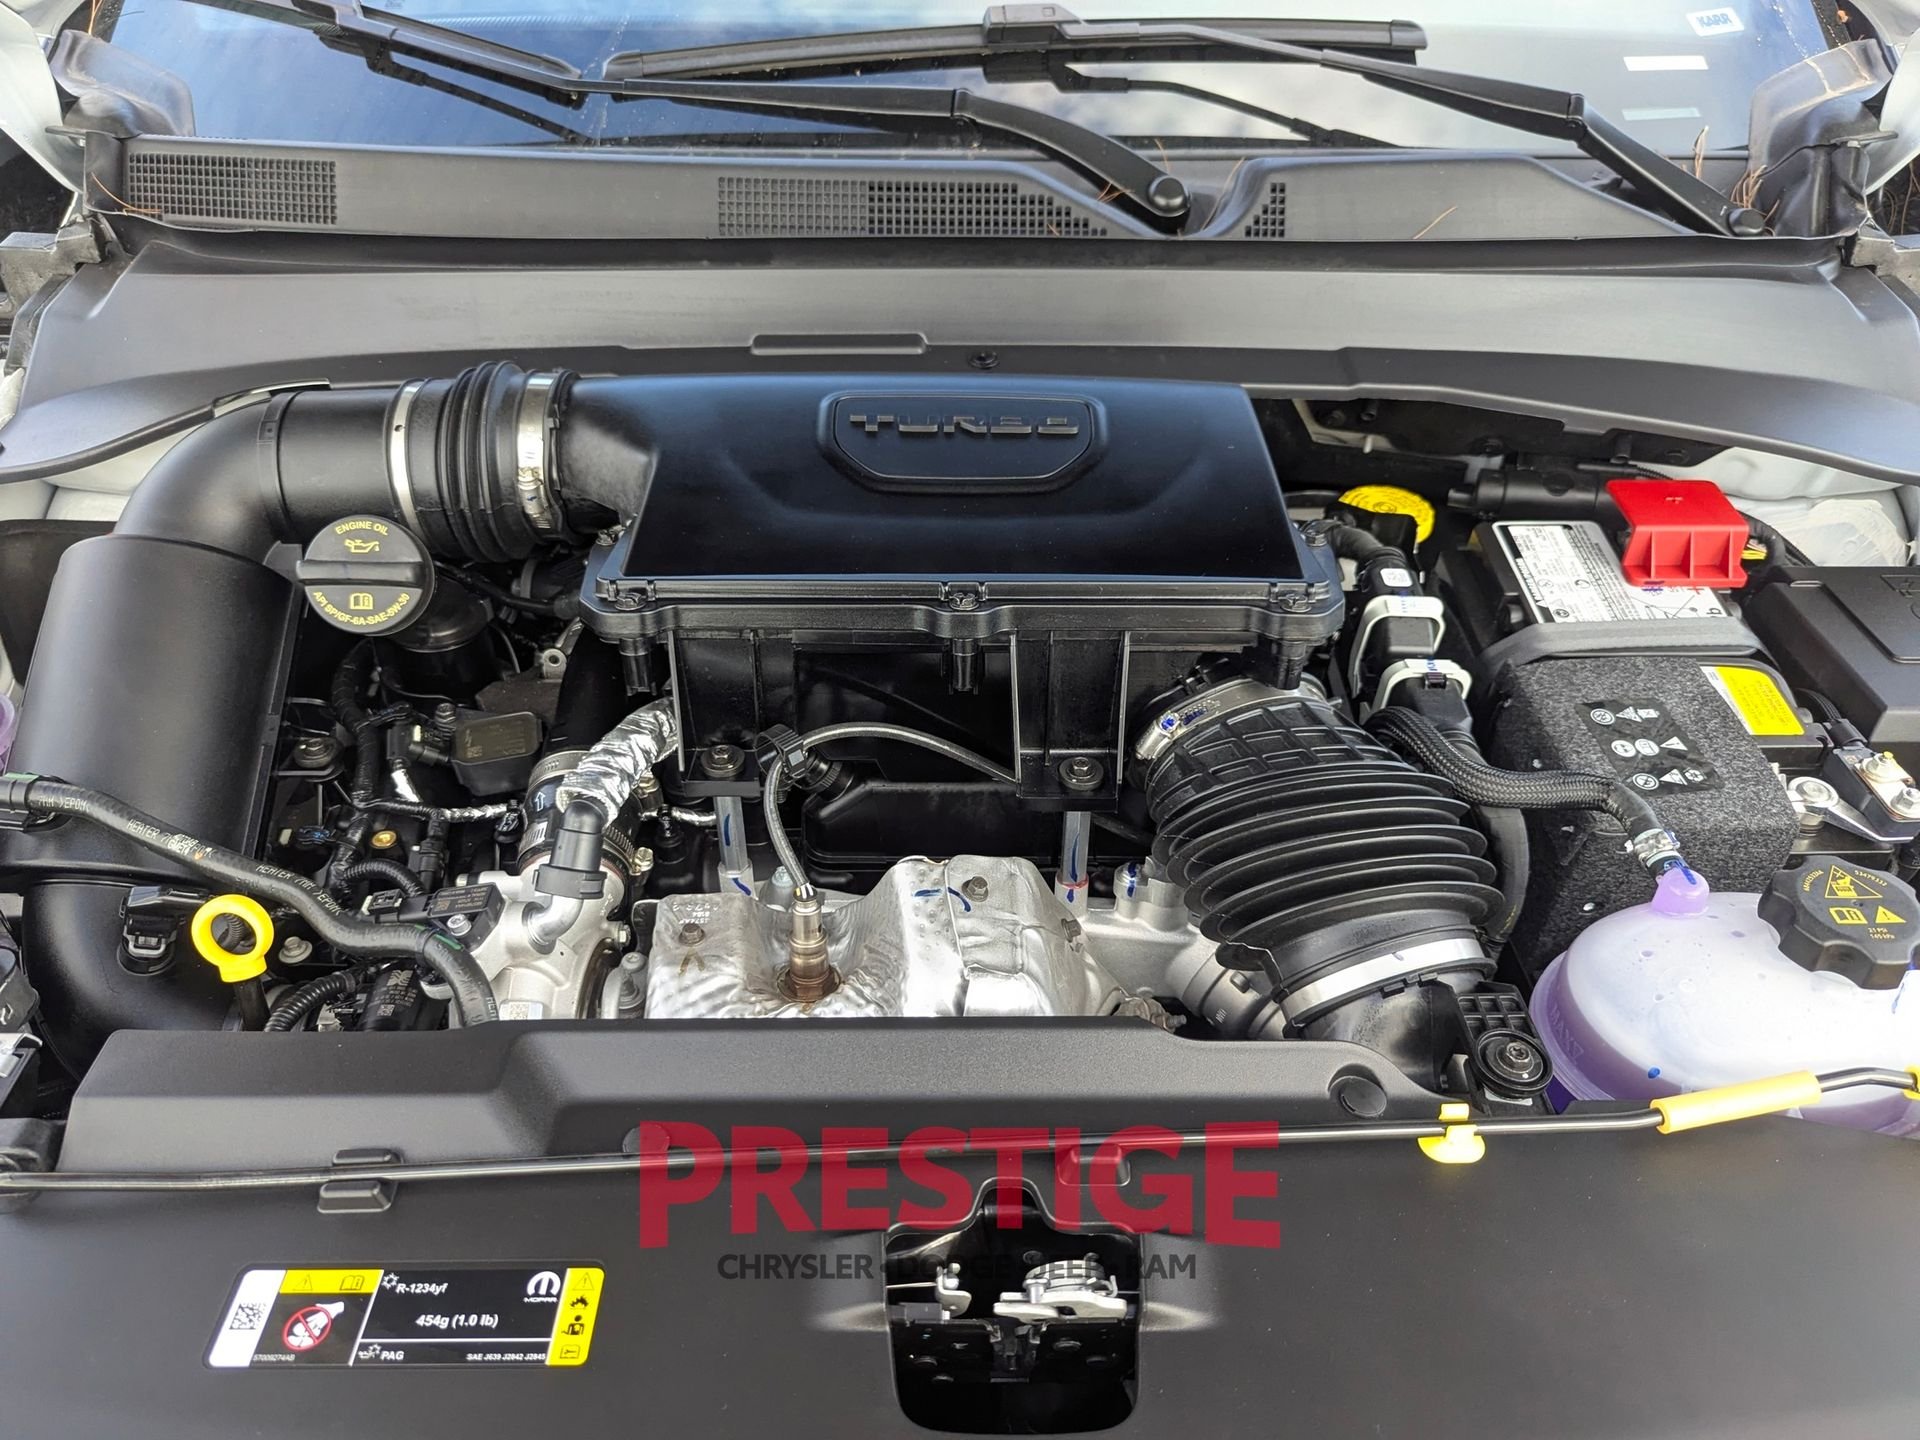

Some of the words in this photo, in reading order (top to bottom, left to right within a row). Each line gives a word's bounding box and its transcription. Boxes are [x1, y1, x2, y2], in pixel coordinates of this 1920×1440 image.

[335, 521, 372, 535] ENGINE
[373, 524, 389, 536] OIL
[313, 591, 329, 607] API
[127, 819, 160, 840] HEATER
[396, 1283, 448, 1295] R-1234yf
[415, 1314, 449, 1329] 454g
[452, 1314, 478, 1329] (1.0
[480, 1314, 499, 1329] lb)
[381, 1350, 404, 1361] PAG
[466, 1353, 483, 1361] SAE
[483, 1353, 501, 1361] J639
